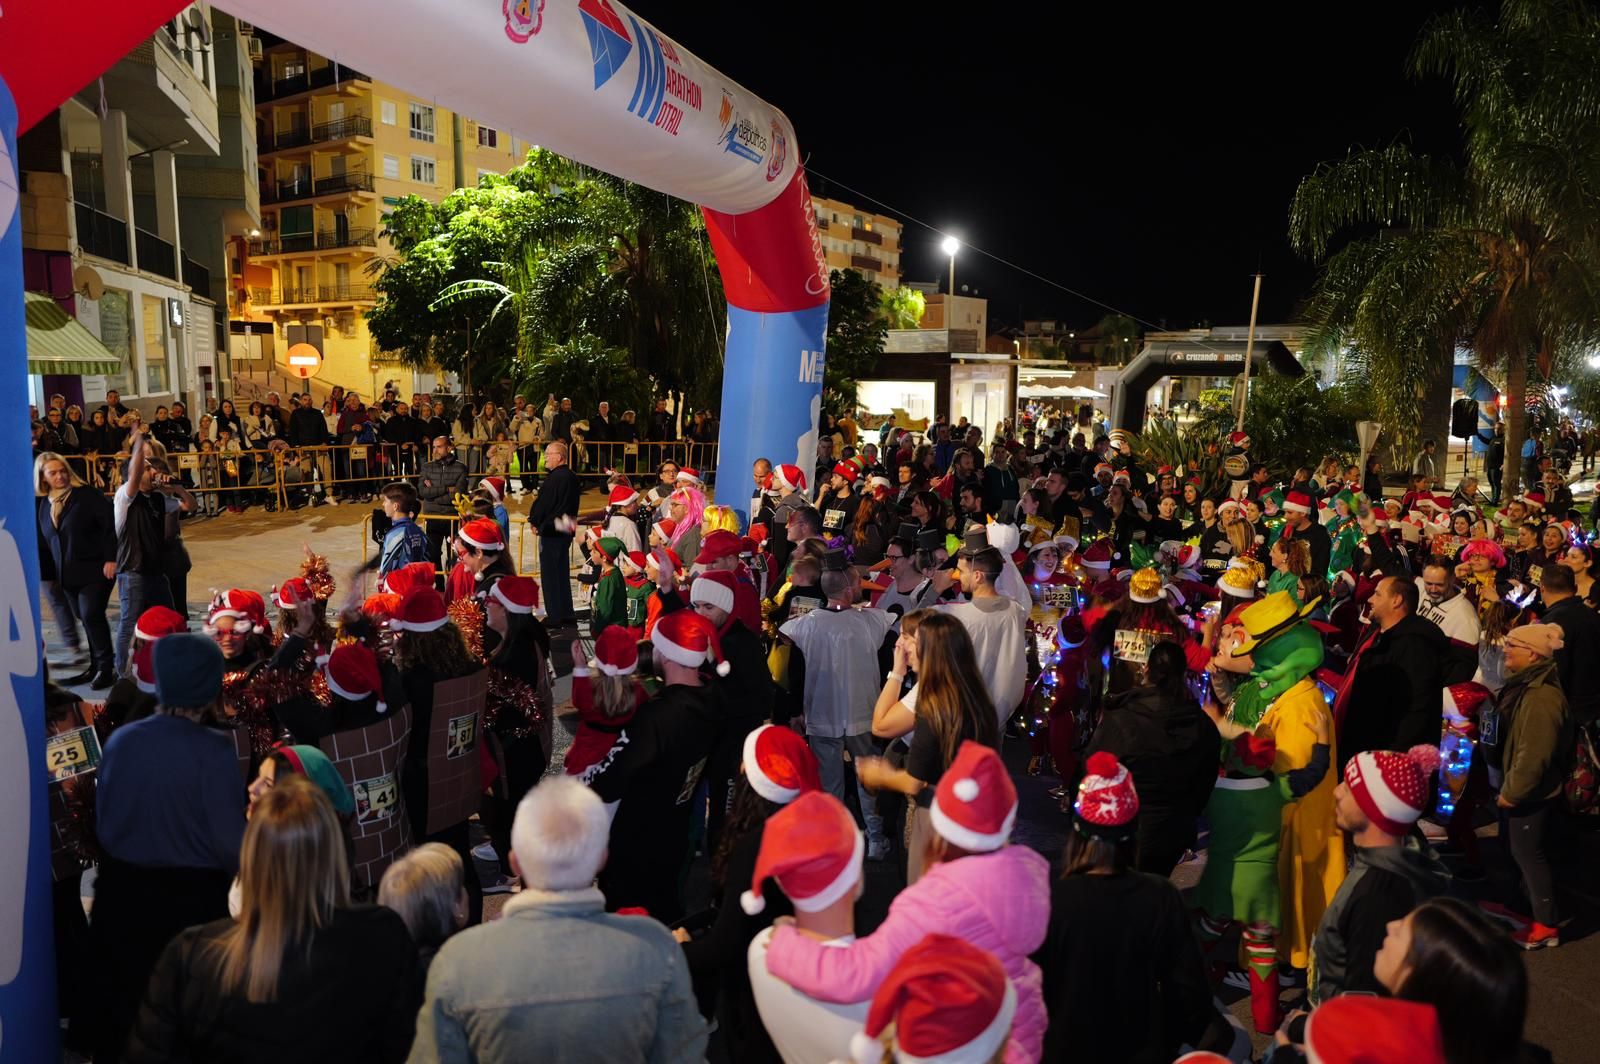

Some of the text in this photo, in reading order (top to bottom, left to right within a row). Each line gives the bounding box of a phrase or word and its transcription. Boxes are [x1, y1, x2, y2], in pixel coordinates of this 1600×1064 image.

[1051, 592, 1071, 601] 223
[1124, 641, 1145, 652] 756
[460, 727, 472, 743] 87
[52, 747, 79, 766] 25
[377, 786, 395, 804] 41
